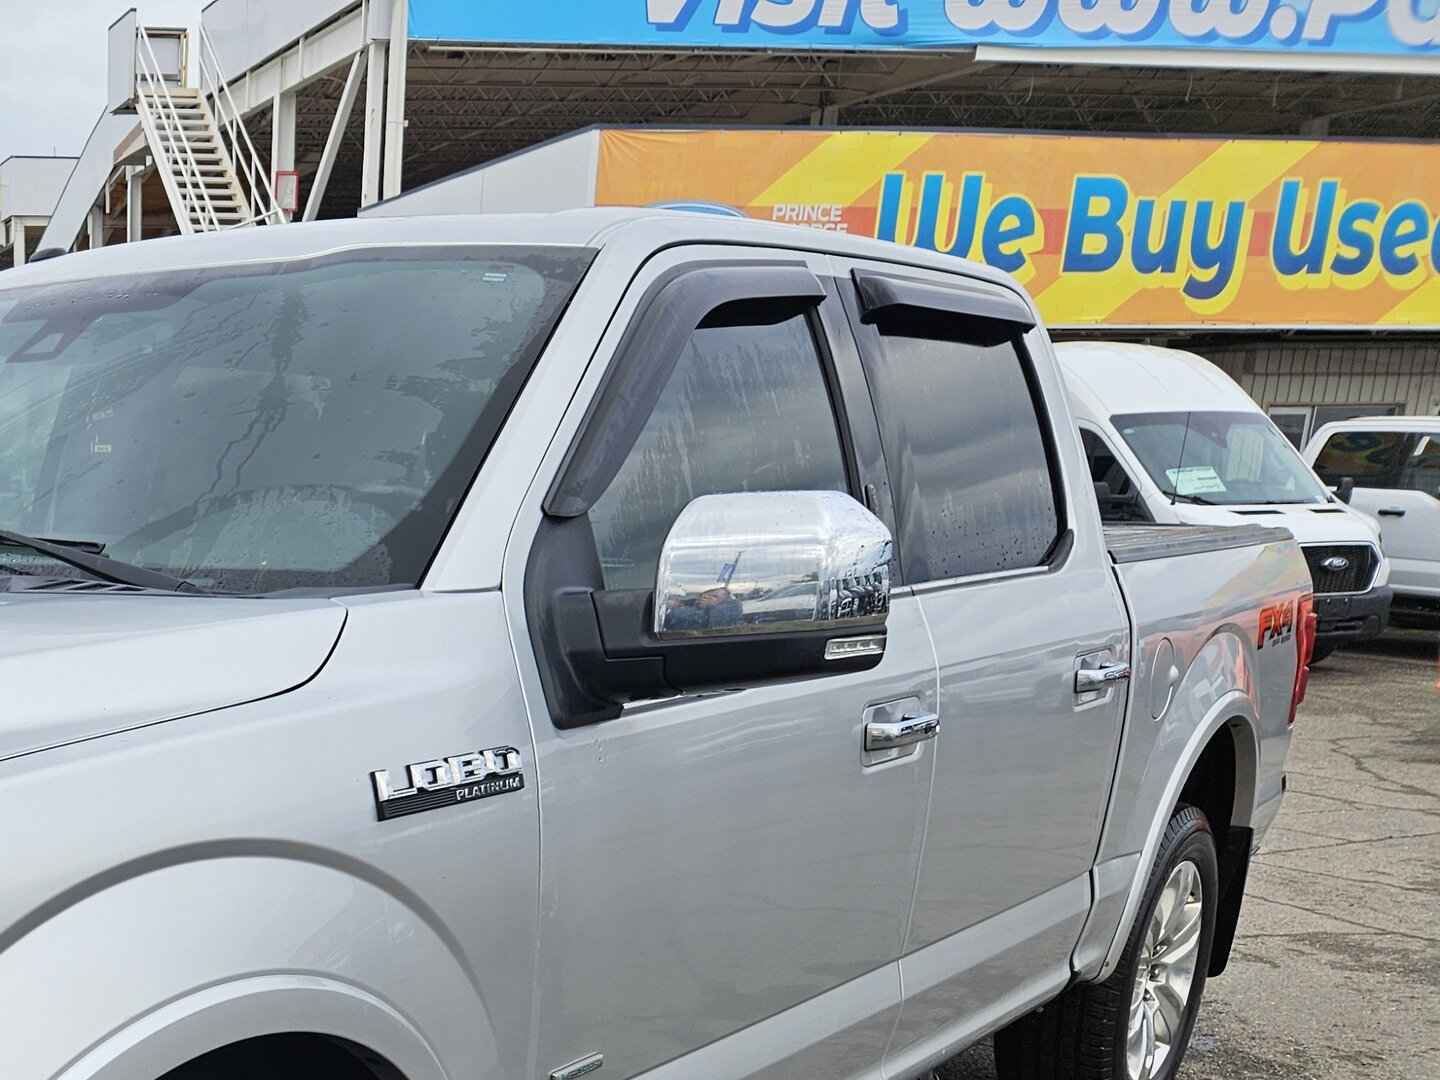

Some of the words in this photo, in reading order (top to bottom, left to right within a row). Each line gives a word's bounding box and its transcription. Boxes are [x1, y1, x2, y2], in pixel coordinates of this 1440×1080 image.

[772, 203, 843, 221] PRINCE
[874, 172, 1037, 273] We
[1061, 175, 1247, 301] Buy
[1271, 178, 1440, 277] Use
[1257, 599, 1294, 651] FX4
[371, 745, 524, 802] LOBO
[456, 777, 521, 801] PLATINUM
